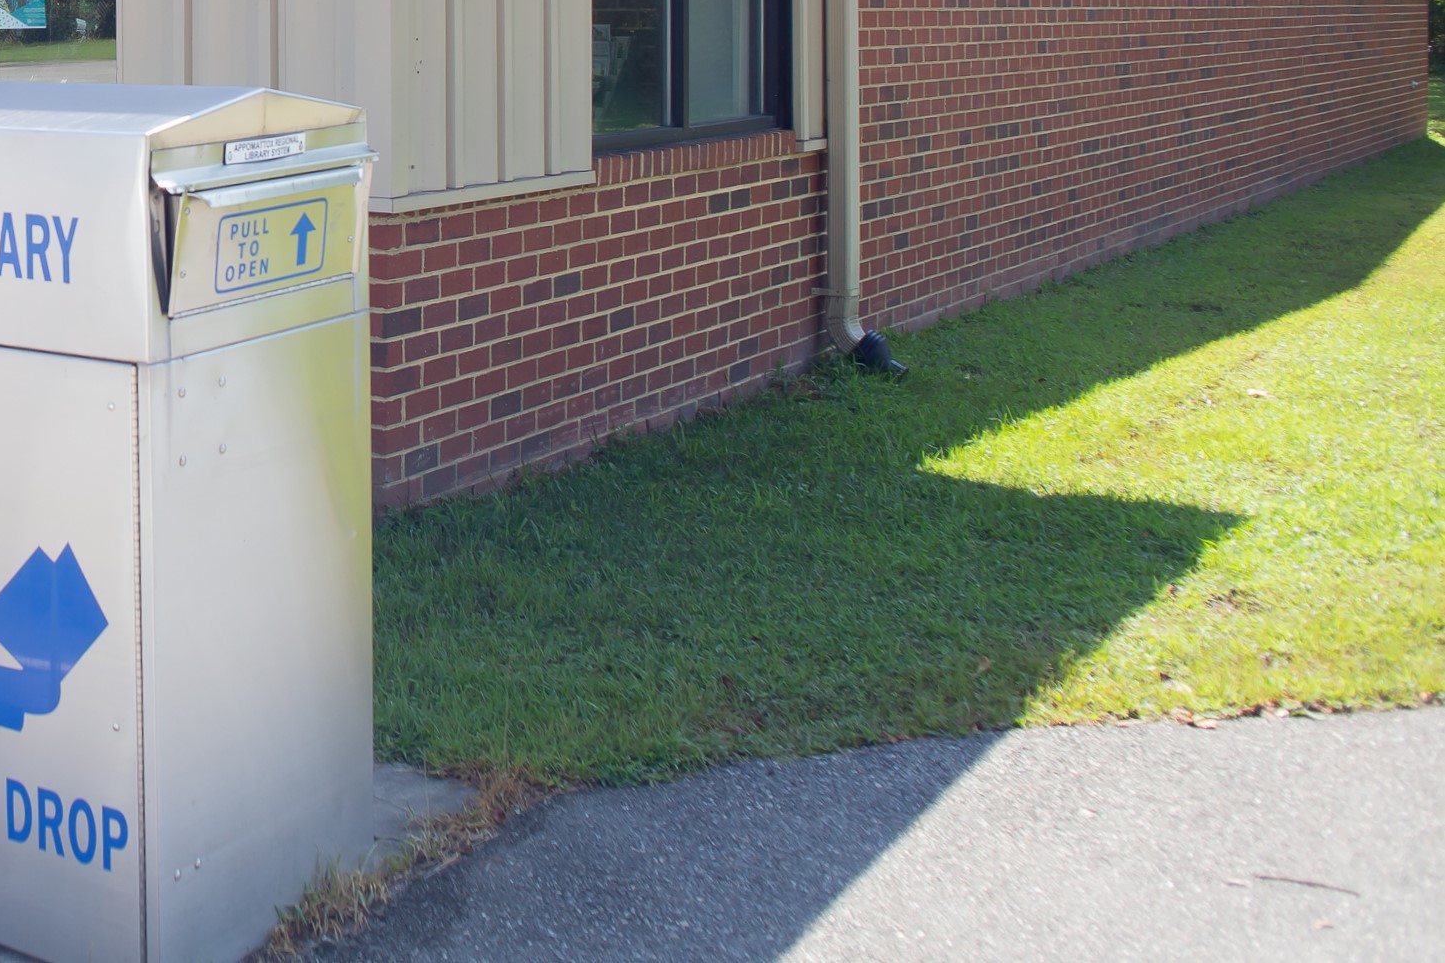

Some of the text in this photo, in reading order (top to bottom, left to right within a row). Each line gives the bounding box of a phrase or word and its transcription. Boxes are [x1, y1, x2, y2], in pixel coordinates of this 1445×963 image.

[234, 136, 299, 152] APPOMATTOX REGIONAL
[244, 146, 290, 160] LIBRARY SYSTEM
[230, 217, 269, 241] PULL
[238, 240, 259, 259] TO
[225, 257, 269, 282] OPEN
[5, 777, 129, 872] DROP
